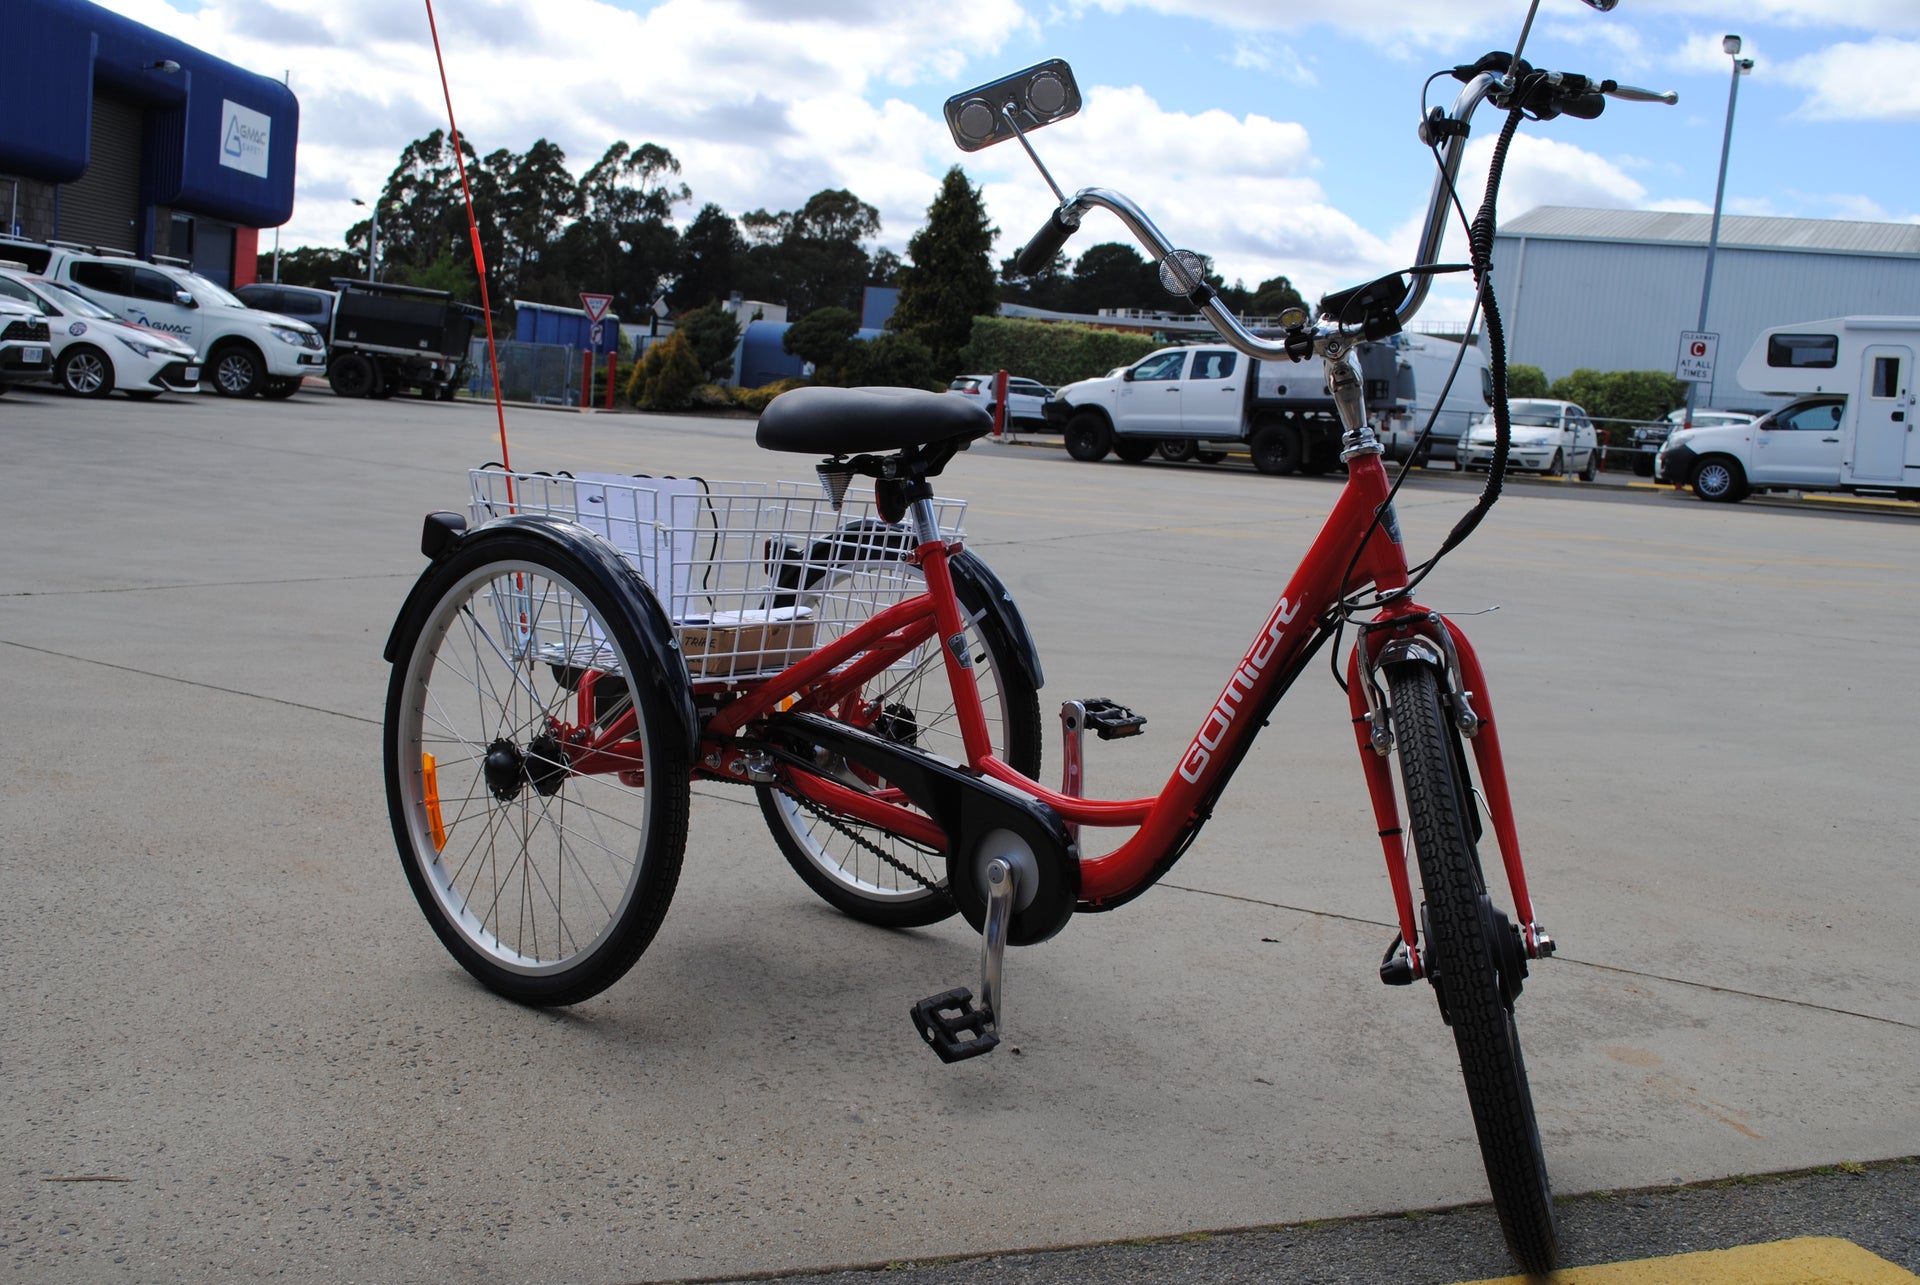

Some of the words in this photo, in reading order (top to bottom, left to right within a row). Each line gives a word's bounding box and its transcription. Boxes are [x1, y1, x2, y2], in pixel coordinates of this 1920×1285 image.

[1693, 342, 1703, 355] C
[1681, 359, 1691, 367] AT
[1695, 361, 1711, 369] ALL
[1683, 369, 1707, 378] TIMES
